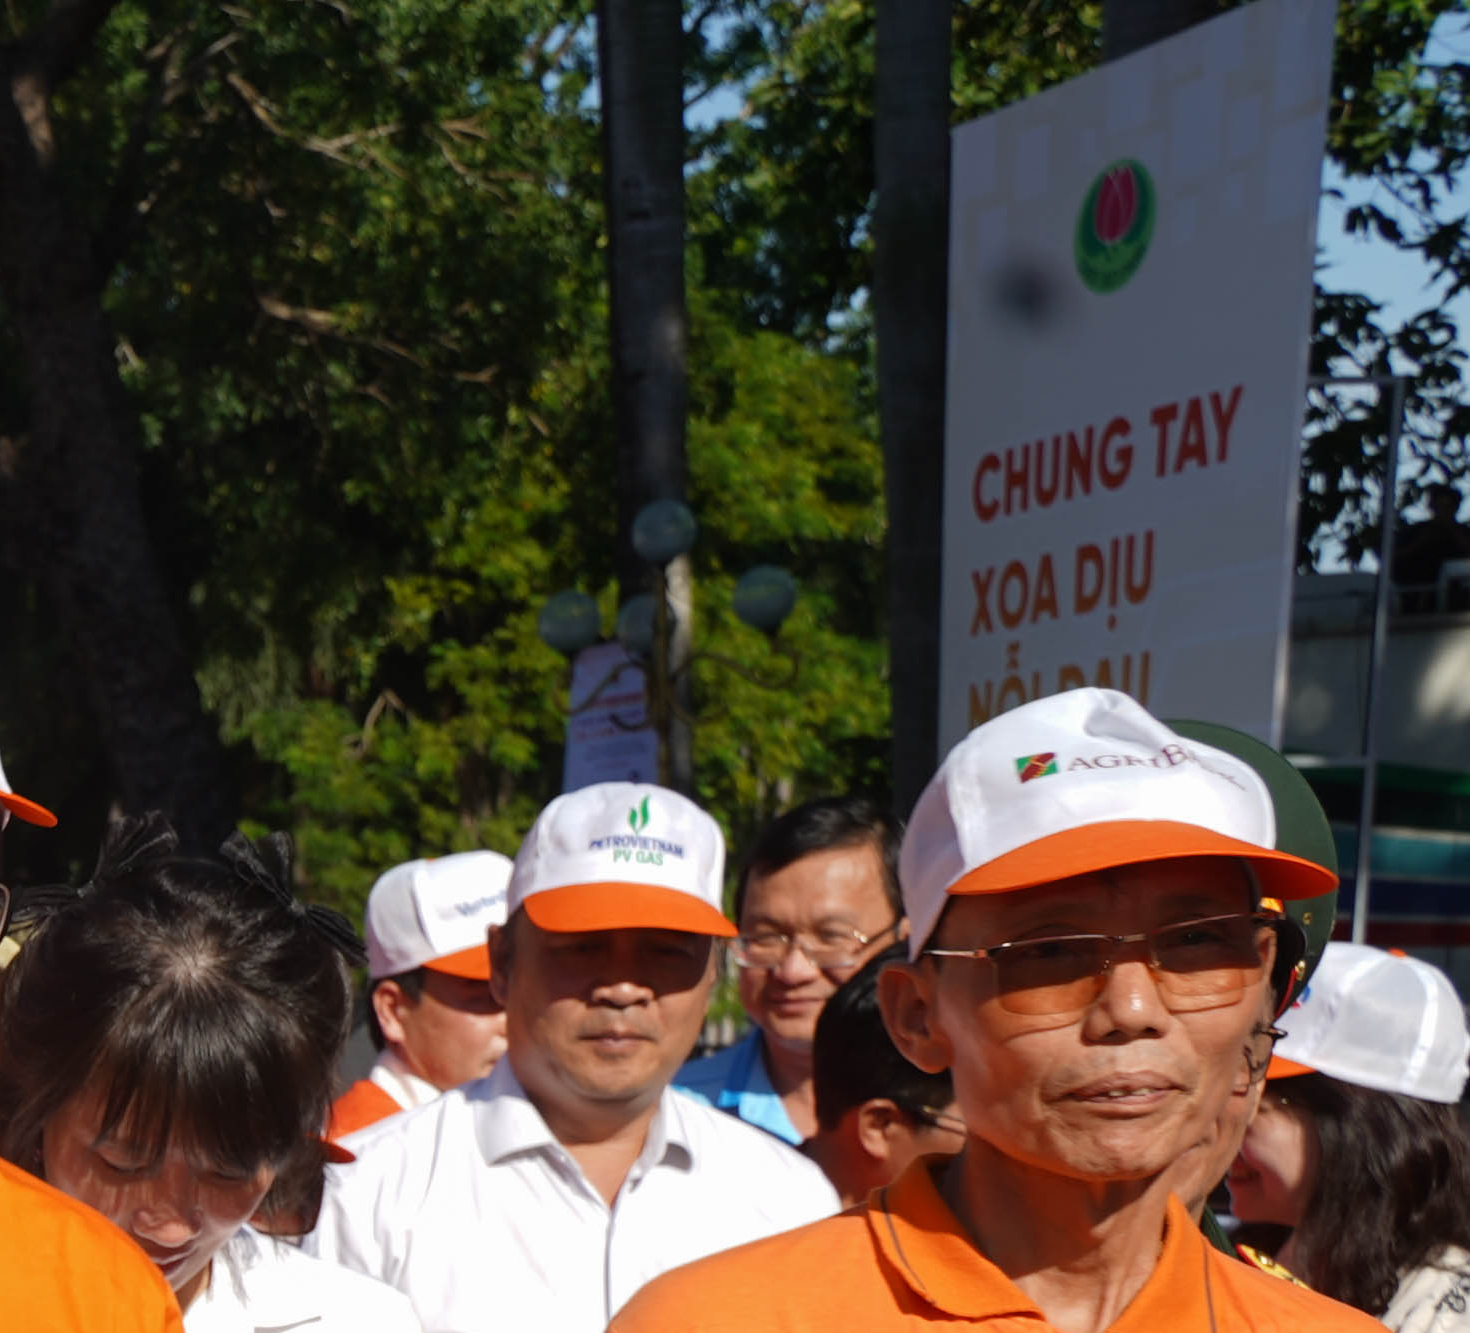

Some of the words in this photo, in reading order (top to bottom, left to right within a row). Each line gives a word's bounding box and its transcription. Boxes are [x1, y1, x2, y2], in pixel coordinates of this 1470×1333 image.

[972, 416, 1135, 523] CHUNG
[1150, 385, 1244, 478] TAY
[971, 553, 1058, 637] XOA
[1073, 530, 1155, 631] DỊU
[613, 849, 632, 863] PV
[636, 850, 664, 866] GAS
